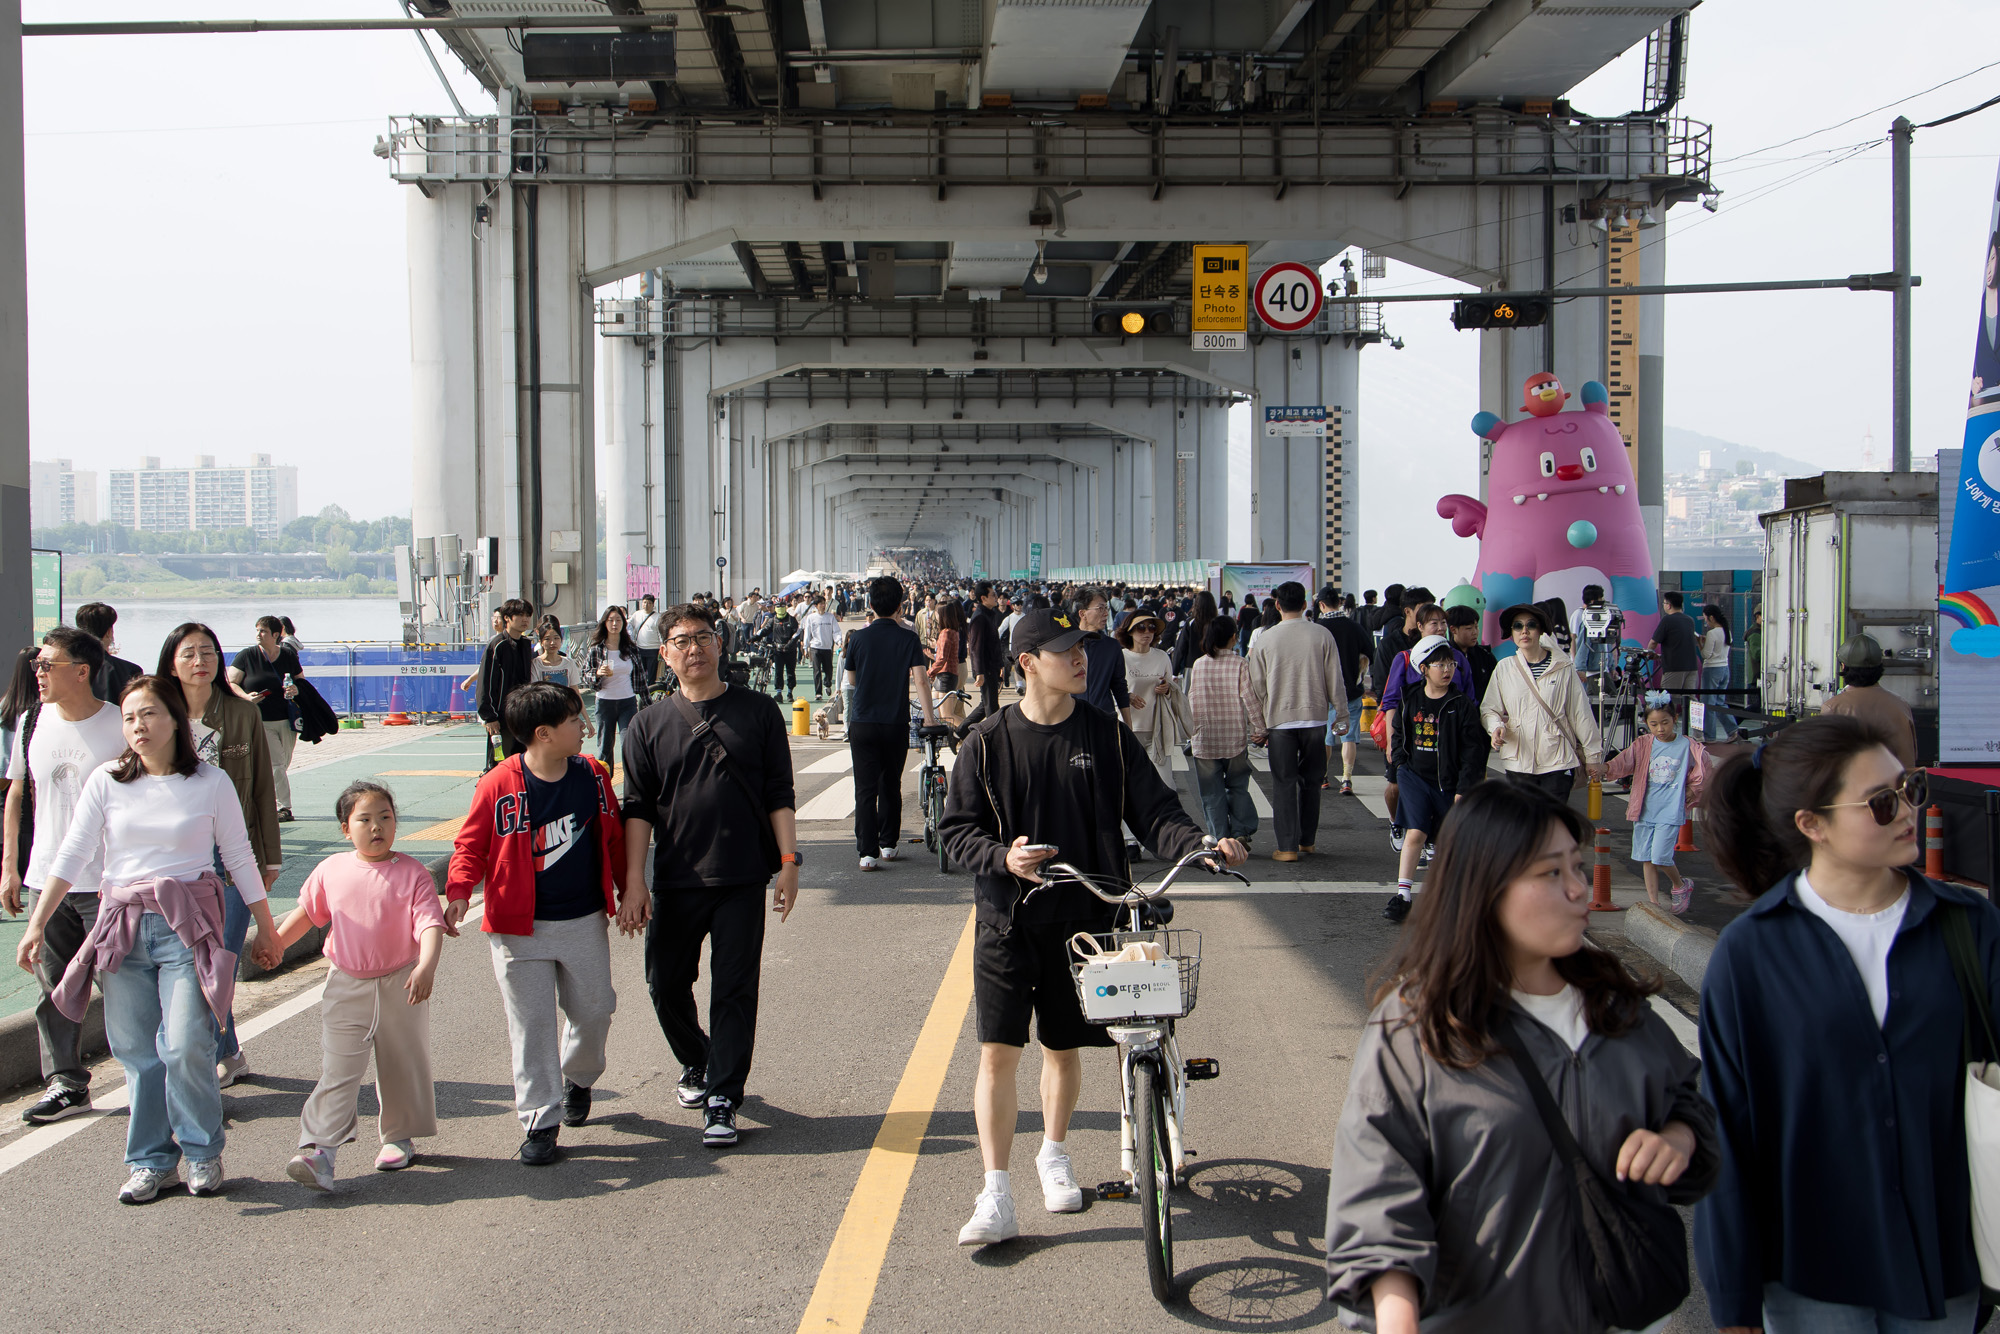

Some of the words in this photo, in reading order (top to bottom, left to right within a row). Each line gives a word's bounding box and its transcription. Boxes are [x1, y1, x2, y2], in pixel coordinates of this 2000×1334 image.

[1200, 284, 1240, 298] 단속중
[1268, 282, 1309, 312] 40
[1204, 303, 1235, 313] Photo
[1197, 315, 1242, 323] enforcement
[1203, 334, 1236, 348] 800m
[1269, 408, 1284, 416] 과거
[1286, 408, 1300, 416] 최고
[1302, 408, 1324, 416] 홍수위
[1964, 477, 1993, 509] 나에게
[400, 666, 418, 674] 안전
[429, 666, 447, 674] 제일
[531, 812, 578, 852] NIKE
[1119, 983, 1151, 999] 따릉이
